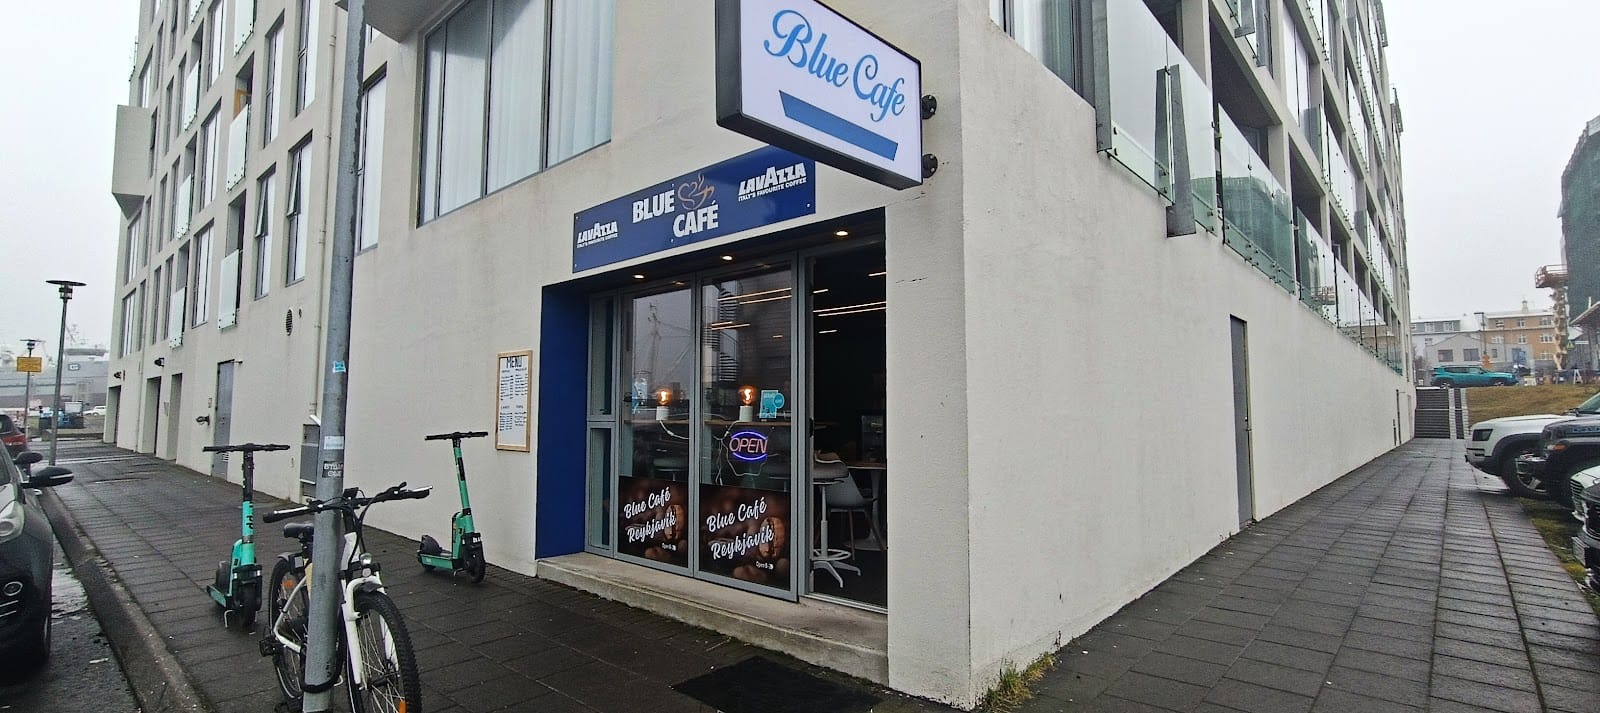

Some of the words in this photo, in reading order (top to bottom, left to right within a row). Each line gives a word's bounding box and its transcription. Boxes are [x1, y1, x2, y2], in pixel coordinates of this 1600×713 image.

[763, 9, 849, 88] Blue
[853, 54, 906, 123] Cafe
[738, 162, 807, 196] LAVAZZA
[632, 189, 676, 224] BLUE
[672, 199, 719, 238] CAFÉ
[577, 221, 619, 244] LAVAZZA
[728, 437, 768, 454] OPEN
[623, 499, 647, 519] Blue
[648, 486, 672, 509] Café
[706, 514, 736, 533] Blue
[737, 496, 768, 522] Café
